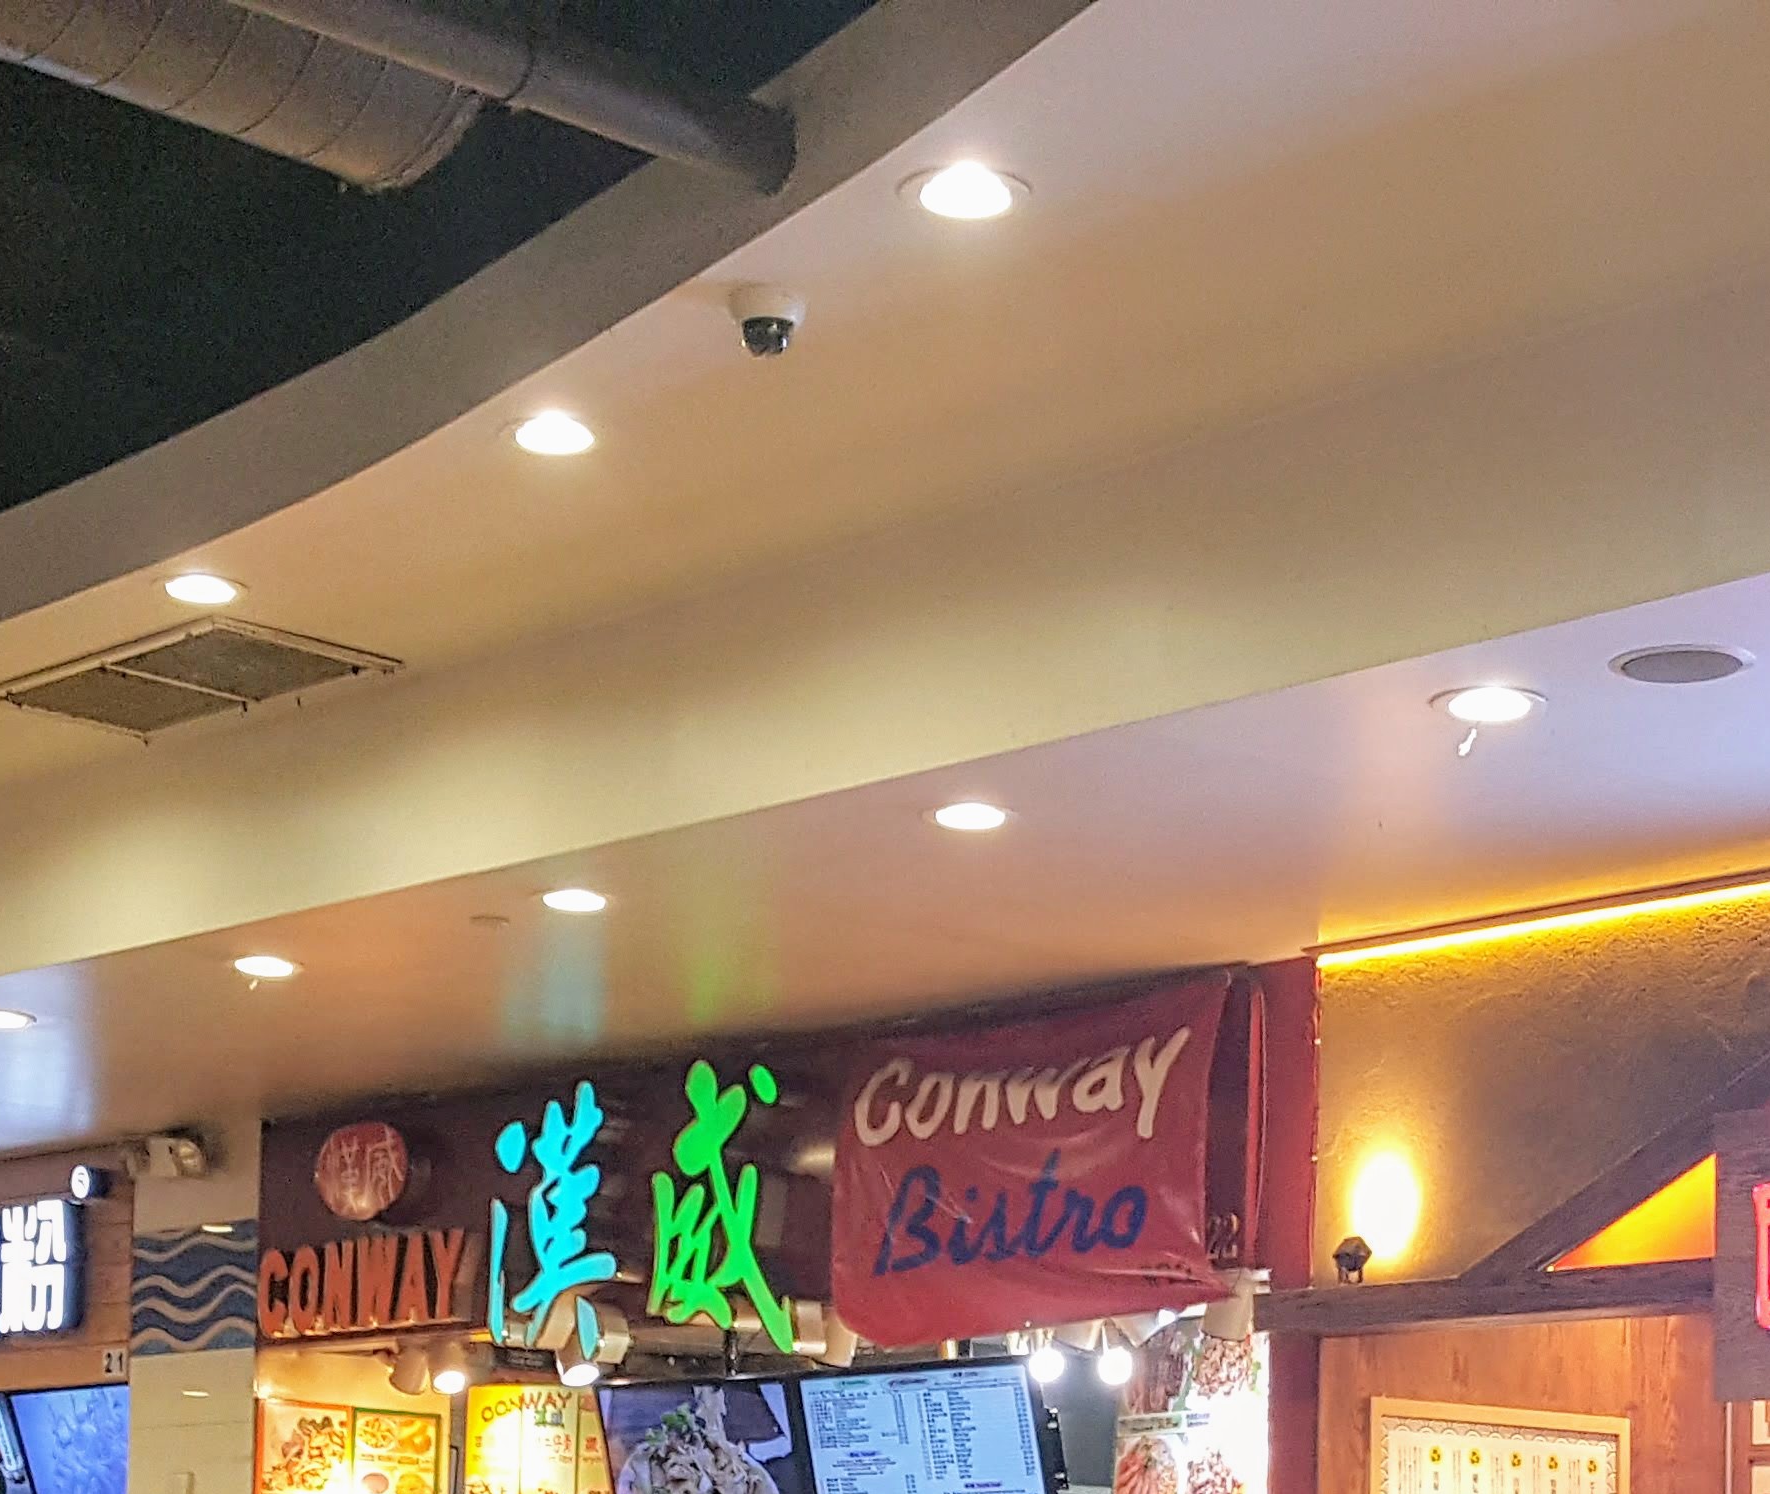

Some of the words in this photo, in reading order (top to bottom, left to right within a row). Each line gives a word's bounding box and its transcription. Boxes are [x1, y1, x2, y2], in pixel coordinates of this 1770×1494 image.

[853, 1026, 1191, 1147] Conway
[872, 1150, 1147, 1277] Bistro
[258, 1228, 464, 1339] CONWAY
[104, 1351, 124, 1374] 21
